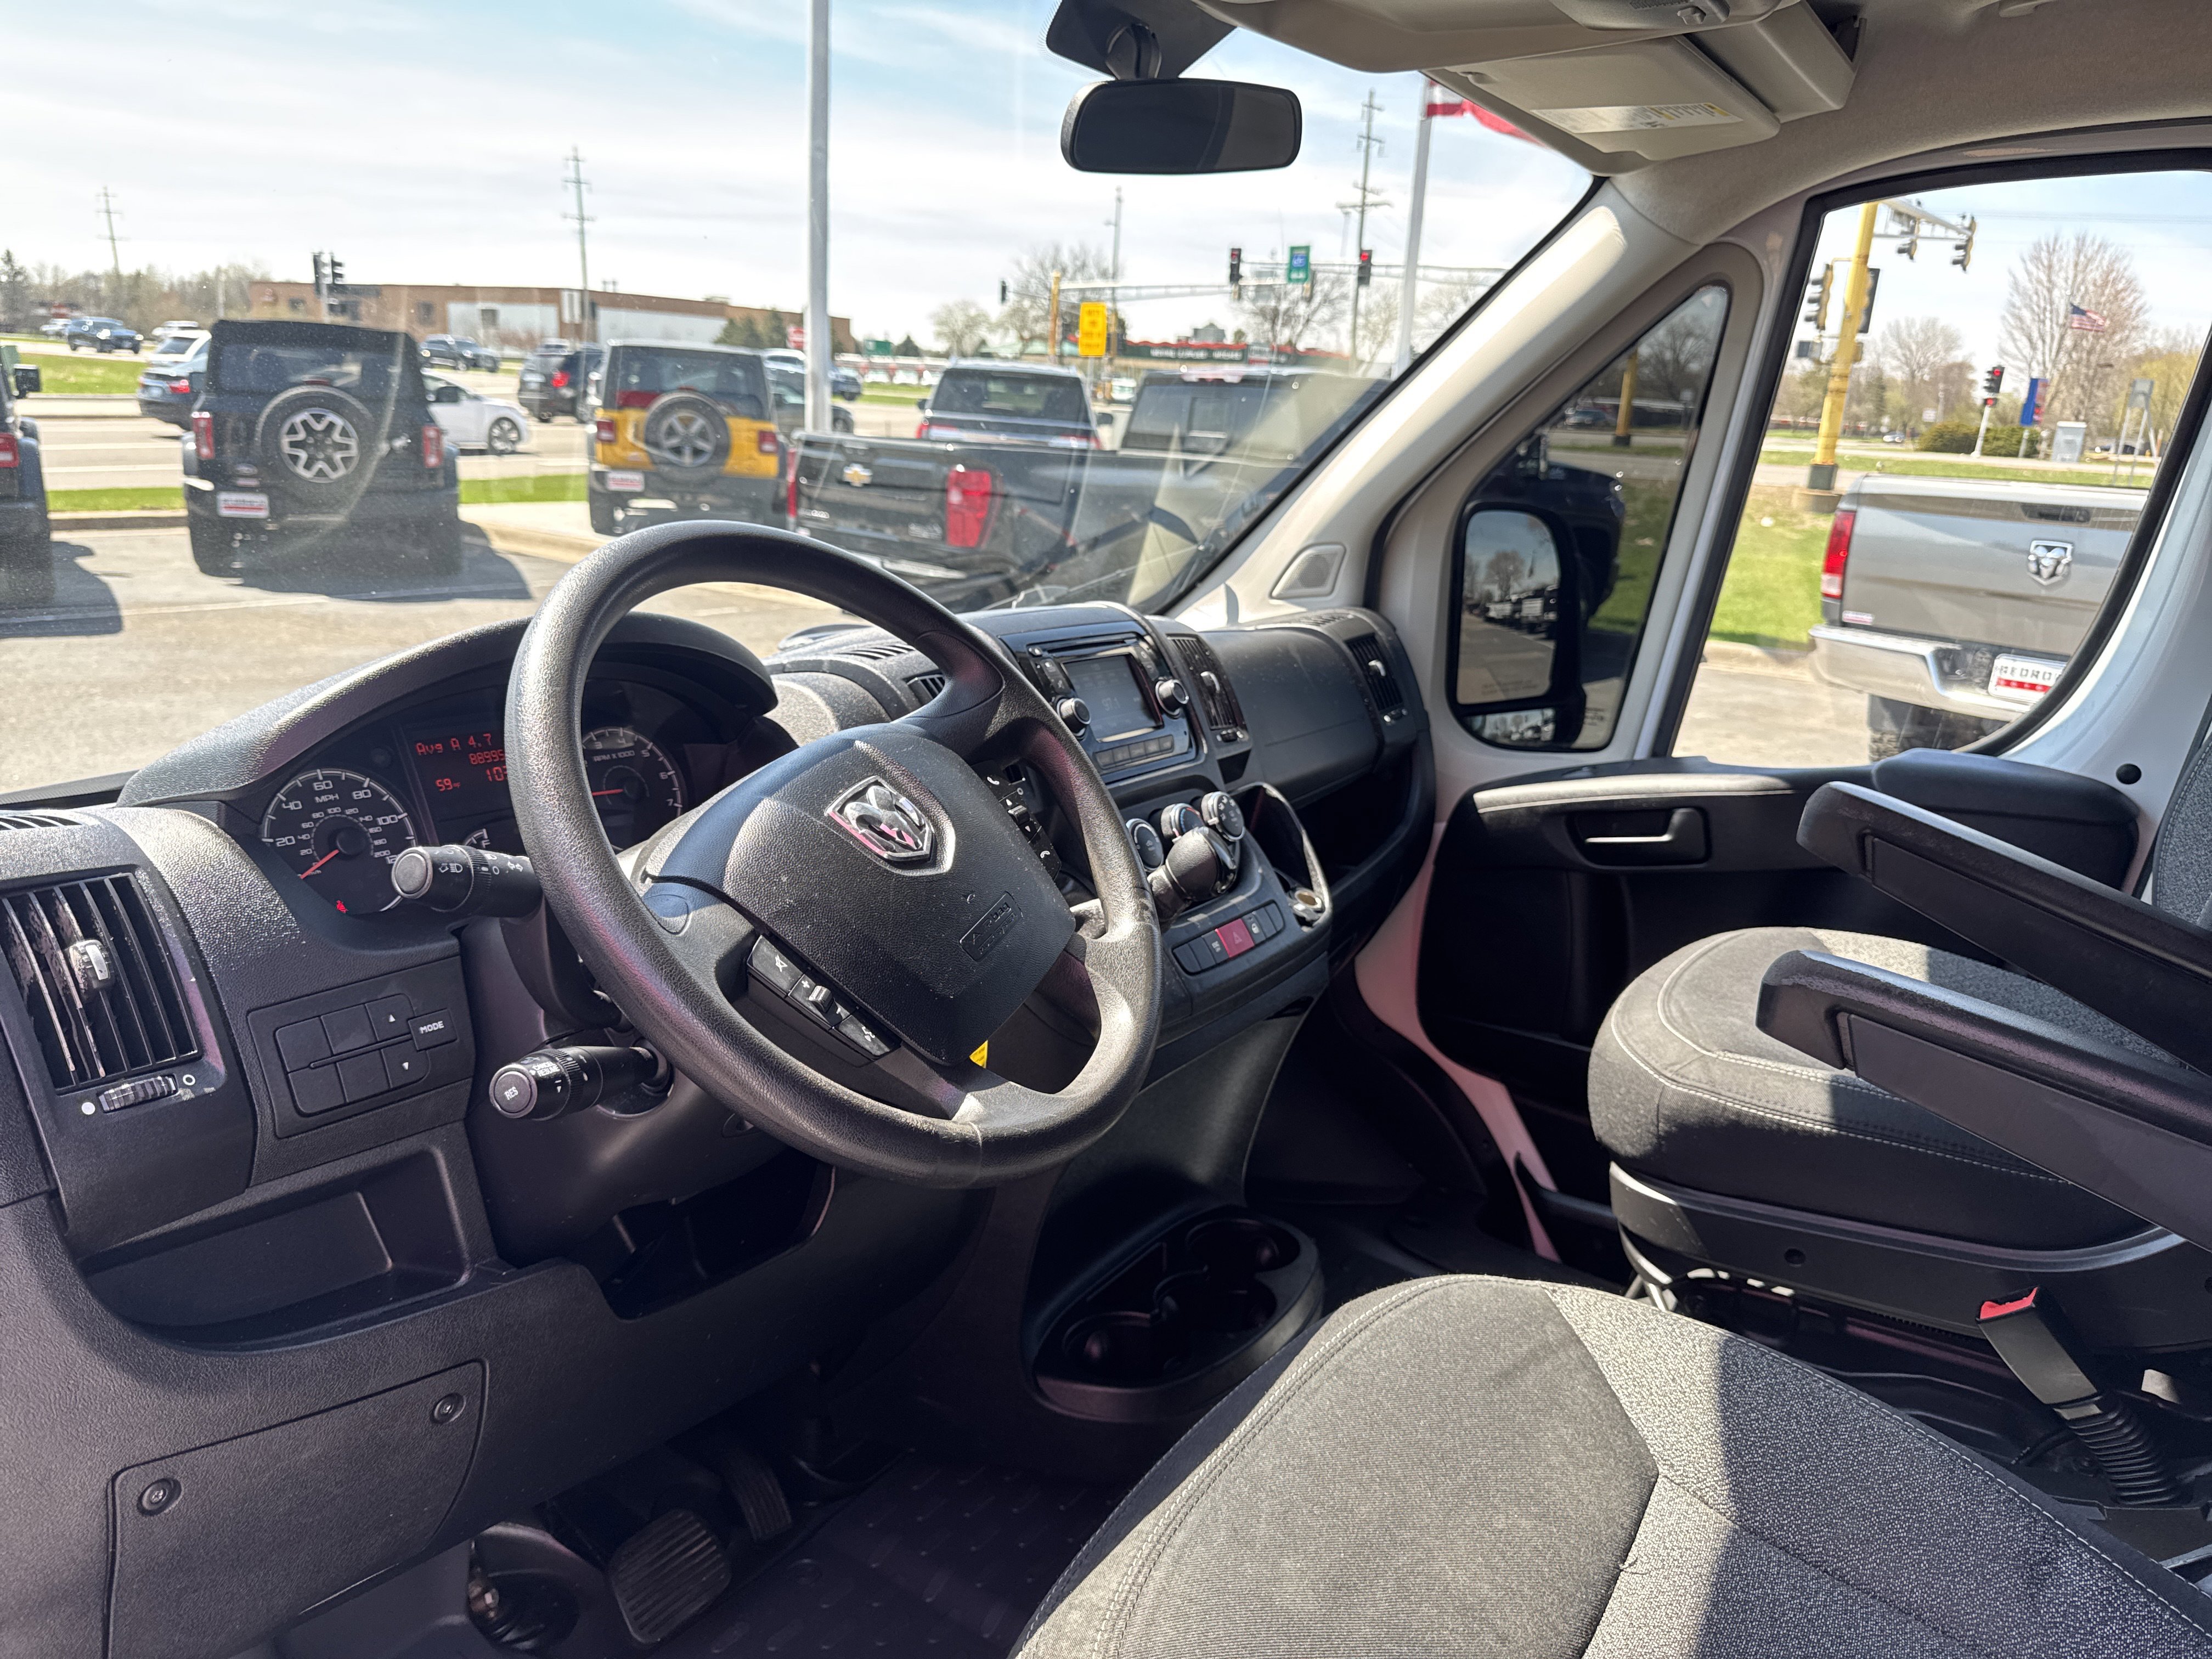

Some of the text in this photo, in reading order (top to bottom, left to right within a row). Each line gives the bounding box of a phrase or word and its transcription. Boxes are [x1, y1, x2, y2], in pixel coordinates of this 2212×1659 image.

[641, 749, 650, 758] 5
[659, 771, 668, 780] 6
[313, 781, 333, 791] 60
[315, 793, 340, 803] MPH
[352, 789, 372, 800] 80
[282, 800, 303, 810] 40
[376, 814, 398, 826] 100
[275, 836, 296, 848] 20
[374, 850, 391, 858] 200
[419, 1020, 444, 1034] MODE
[532, 1061, 556, 1071] CANCEL
[537, 1064, 561, 1077] RESUME
[504, 1086, 518, 1101] RES
